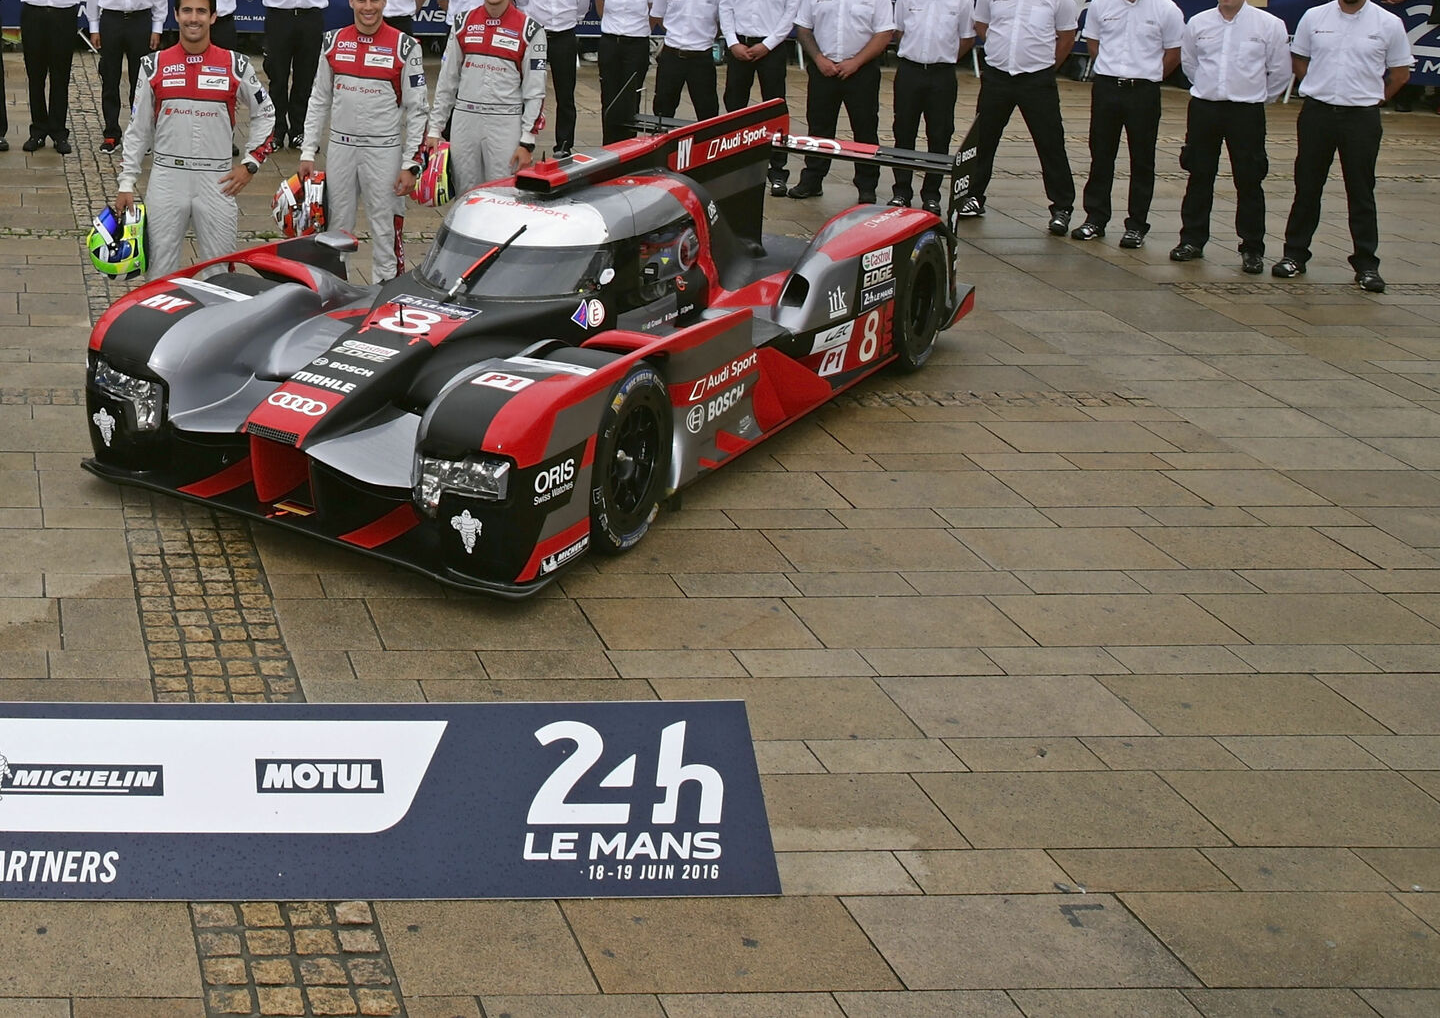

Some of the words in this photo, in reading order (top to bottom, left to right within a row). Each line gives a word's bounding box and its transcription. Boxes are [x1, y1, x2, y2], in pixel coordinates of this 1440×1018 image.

[337, 41, 358, 49] ORIS
[163, 63, 185, 74] ORIS
[360, 86, 382, 94] Sport
[195, 110, 218, 118] Sport
[719, 134, 740, 152] Audi
[741, 126, 767, 146] Sport
[677, 137, 694, 171] HY
[962, 147, 977, 163] BOSCH
[954, 174, 969, 192] ORIS
[486, 197, 523, 209] Audi
[525, 203, 570, 220] Sport
[871, 250, 891, 267] Castrol
[863, 264, 893, 288] EDGE
[140, 295, 184, 311] HY
[828, 285, 847, 312] itk
[874, 293, 880, 301] LE
[880, 288, 894, 299] MANS
[378, 310, 442, 334] 8
[824, 325, 850, 343] WEC
[859, 310, 879, 362] 8
[332, 347, 392, 363] EDGE
[354, 343, 392, 355] Castrol
[329, 361, 374, 377] BOSCH
[707, 366, 729, 390] Audi
[731, 352, 757, 376] Sport
[823, 349, 844, 372] P1
[291, 371, 357, 393] MAHLE
[484, 375, 524, 387] P1
[708, 383, 745, 422] BOSCH
[534, 458, 575, 494] ORIS
[534, 492, 551, 506] Swiss
[551, 481, 574, 498] Watches
[557, 537, 588, 563] MICHELIN
[12, 769, 158, 788] MICHELIN
[262, 763, 378, 790] MOTUL
[526, 720, 725, 825] 24h
[523, 831, 578, 860] LE
[589, 832, 722, 861] MANS
[589, 865, 633, 880] 18-19
[639, 865, 675, 880] JUIN
[682, 864, 720, 879] 2016
